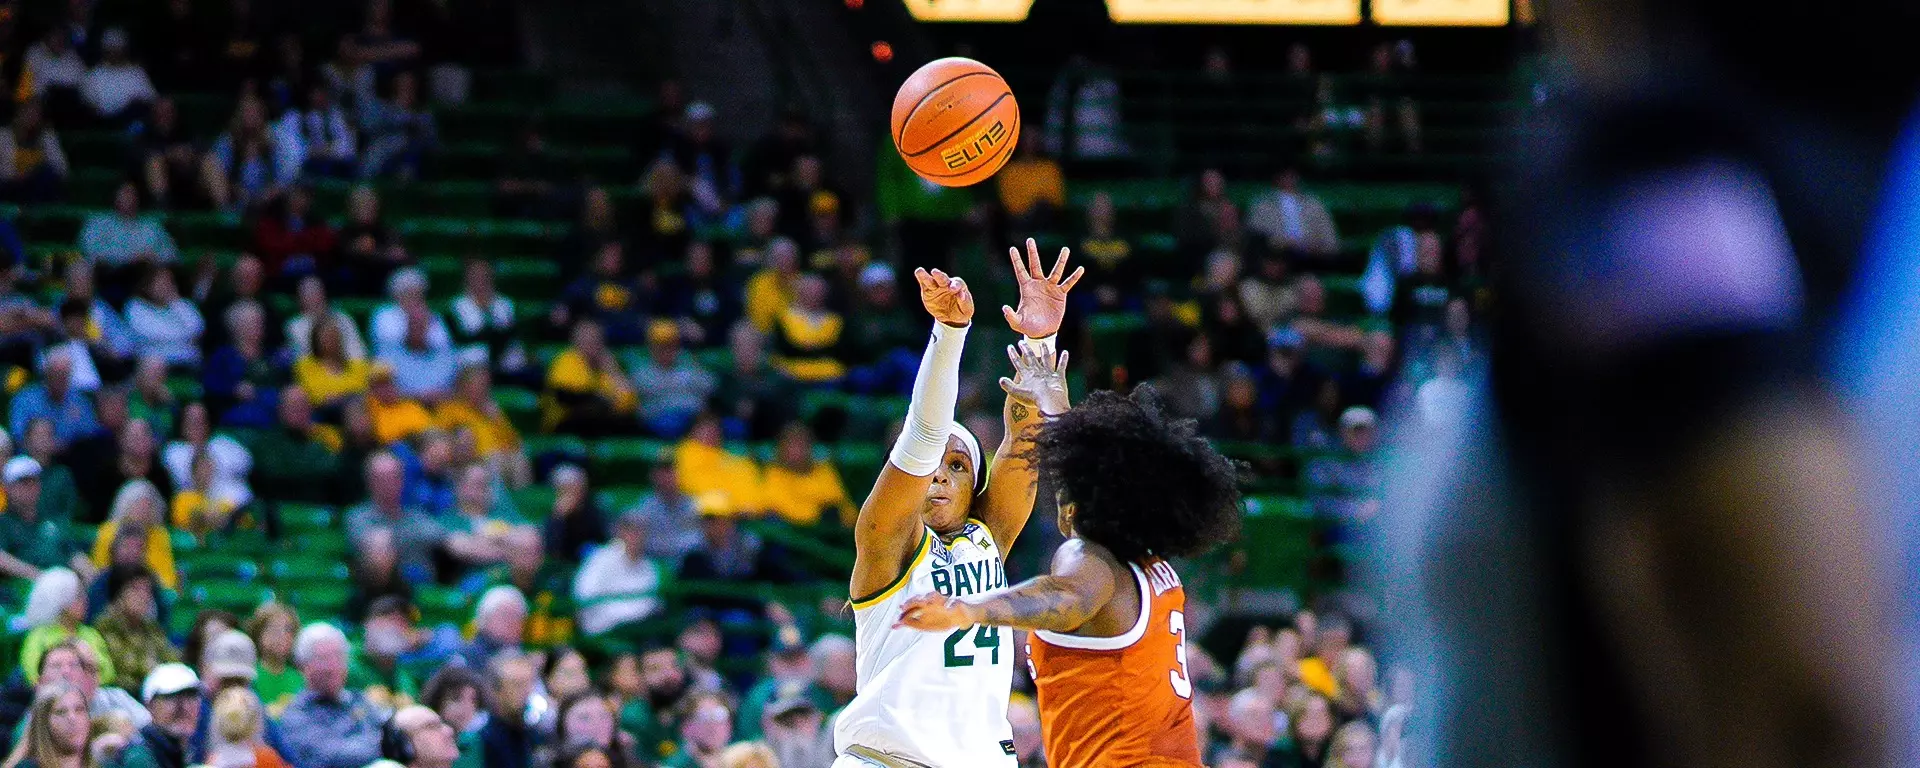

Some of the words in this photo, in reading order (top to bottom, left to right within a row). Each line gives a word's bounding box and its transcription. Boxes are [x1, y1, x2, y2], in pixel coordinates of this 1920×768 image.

[944, 120, 1006, 169] ELITE
[931, 557, 1006, 597] BAYLO
[944, 623, 1000, 667] 24
[1169, 609, 1193, 699] 3
